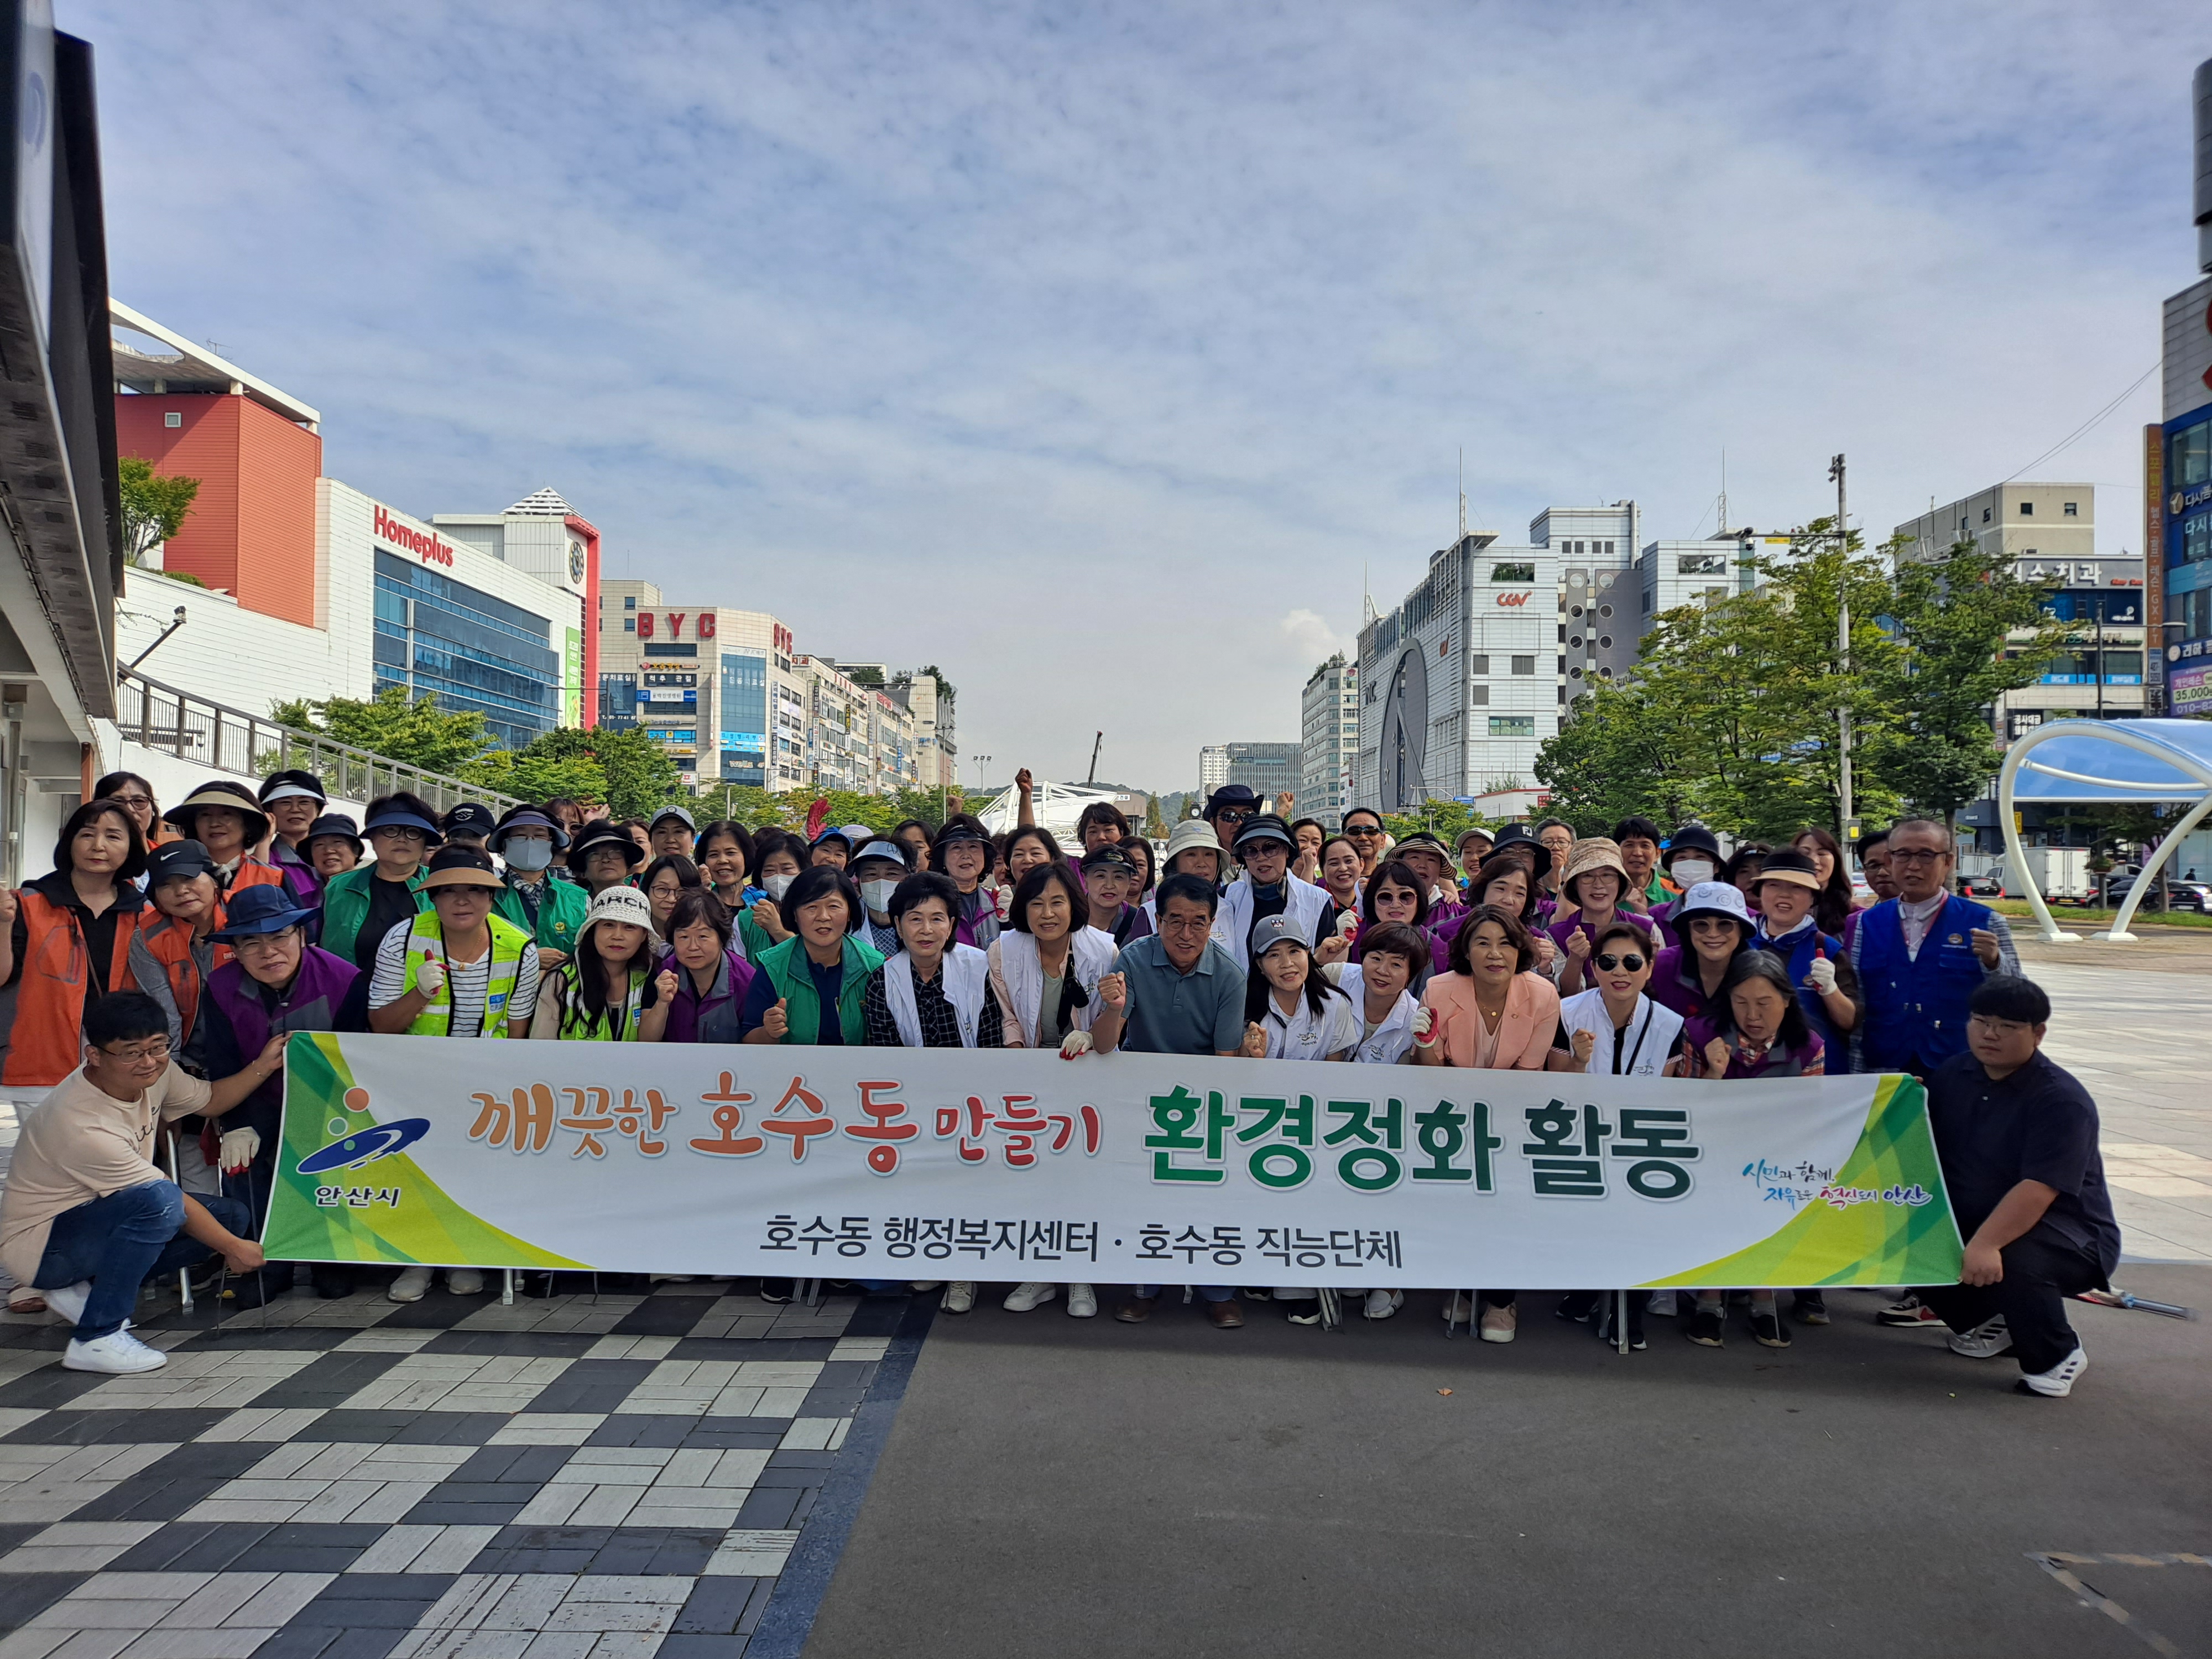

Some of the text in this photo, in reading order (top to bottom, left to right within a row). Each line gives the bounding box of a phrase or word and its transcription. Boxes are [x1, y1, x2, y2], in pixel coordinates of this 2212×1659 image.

[374, 504, 453, 567] Homeplus
[1497, 591, 1532, 607] CGV
[638, 612, 716, 637] BYC
[774, 623, 792, 654] BYC
[2013, 714, 2041, 725] 공사대금
[1522, 826, 1533, 837] FJ
[469, 1072, 1699, 1199] 깨끗한 호수동 만들기 환경정화 활동
[1742, 1159, 1794, 1188] 시민과
[315, 1186, 401, 1208] 안산시
[1764, 1185, 1933, 1211] 자유로운 혁신도시 안산
[760, 1215, 872, 1258] 호수동
[884, 1217, 1099, 1262] 행정복지센터
[1135, 1223, 1246, 1266] 호수동
[1256, 1227, 1402, 1269] 직능단체
